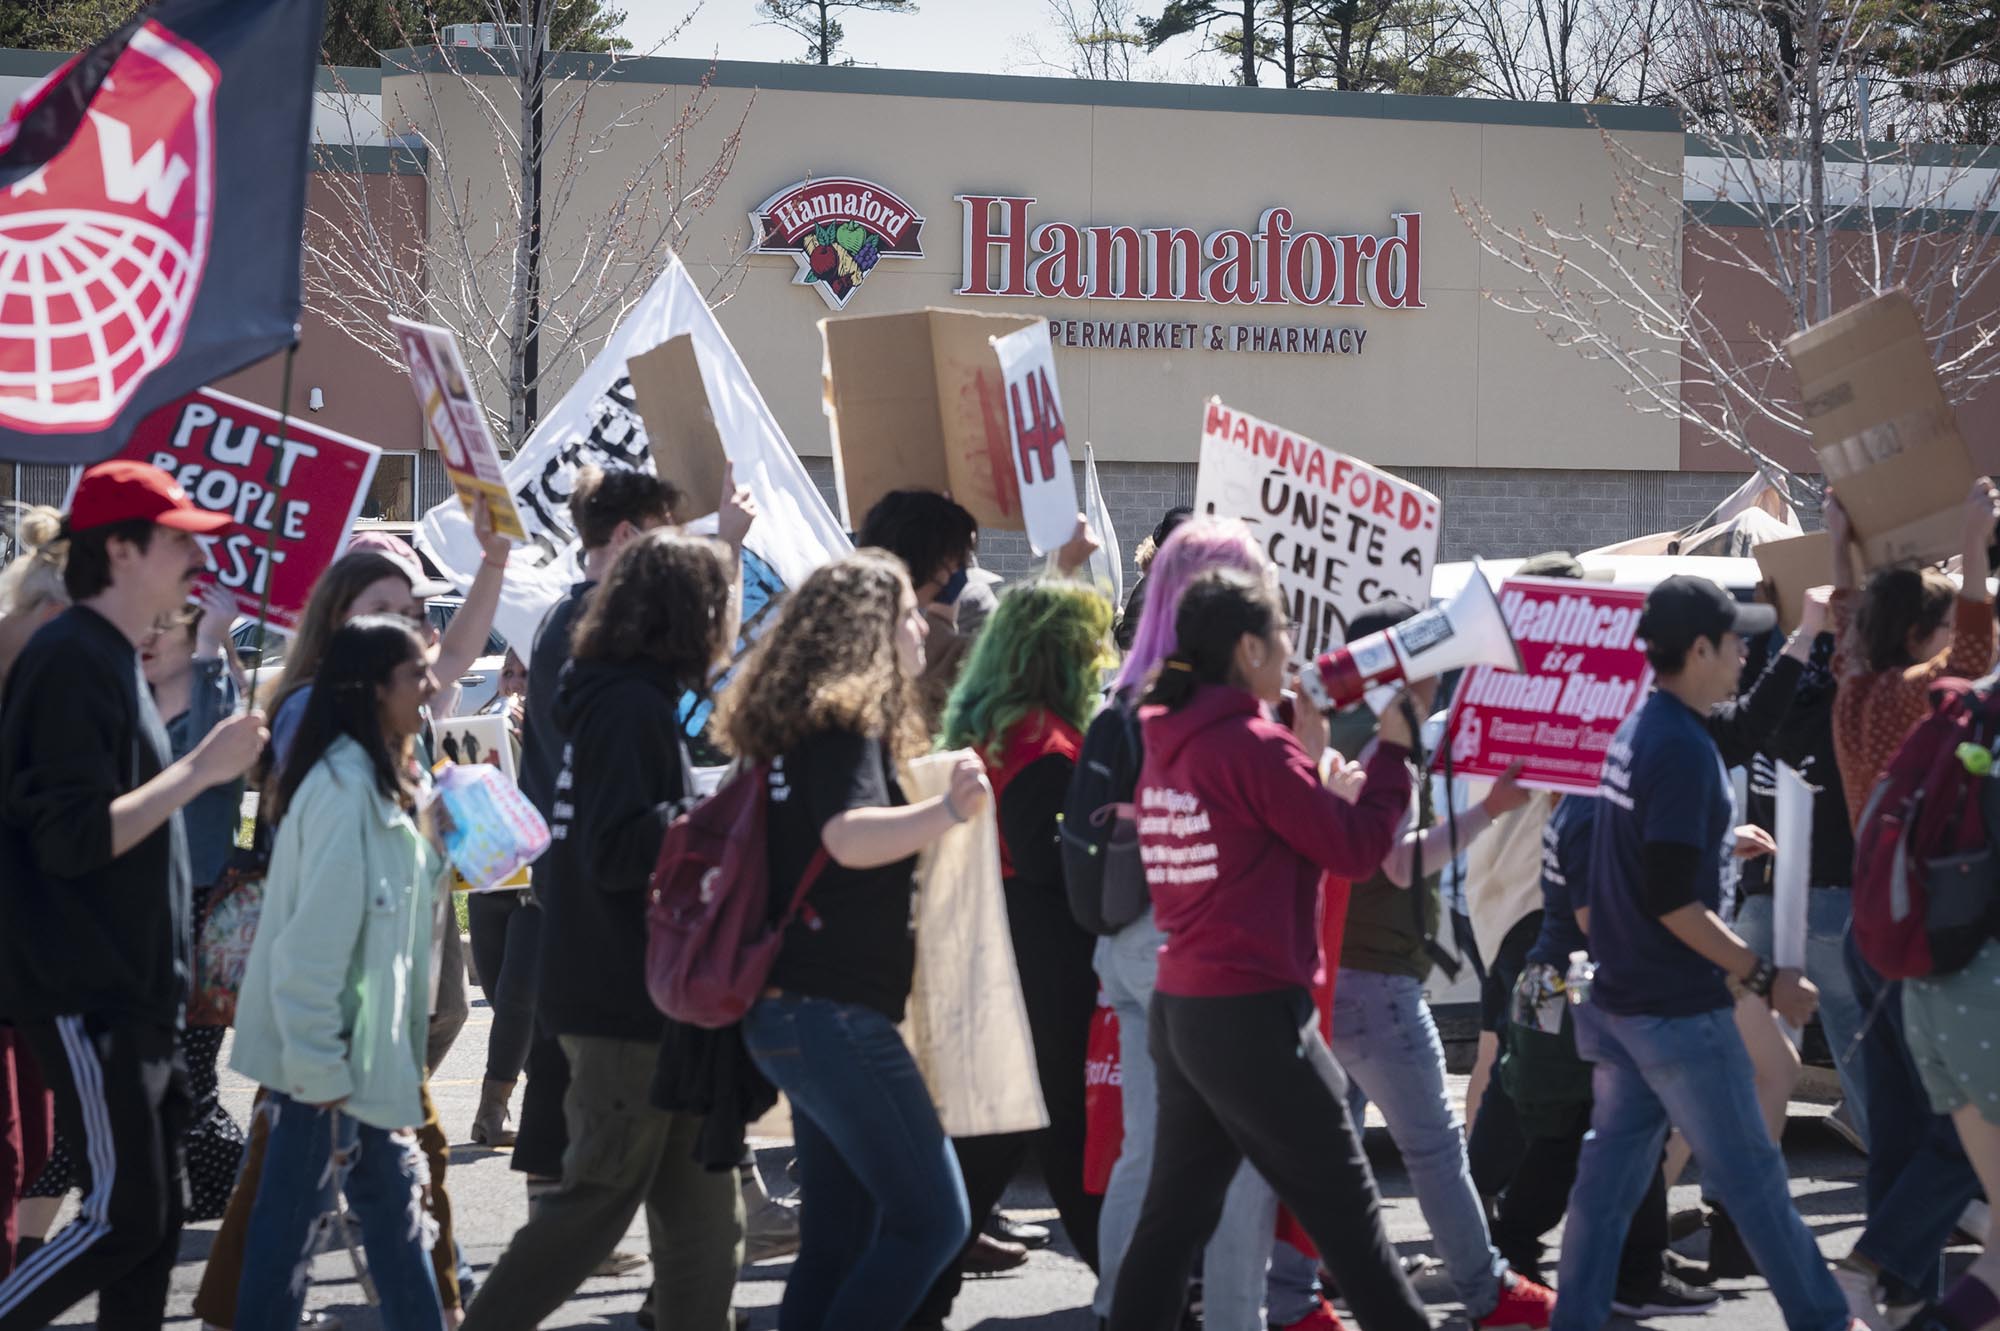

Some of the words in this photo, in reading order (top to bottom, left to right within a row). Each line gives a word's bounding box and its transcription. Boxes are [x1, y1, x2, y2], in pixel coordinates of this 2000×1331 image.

[774, 190, 910, 238] Hannaford
[955, 195, 1426, 309] Hannaford
[1049, 320, 1198, 350] PERMARKET
[1209, 325, 1224, 351] &
[1236, 325, 1367, 355] PHARMACY
[173, 403, 318, 487] PUT
[1206, 405, 1436, 531] HANNAFORD:
[152, 451, 310, 539] PEOPLE
[1401, 547, 1422, 576] A
[1541, 644, 1565, 672] is
[1563, 653, 1584, 672] a
[1464, 664, 1563, 714] Human
[1556, 673, 1637, 724] Right
